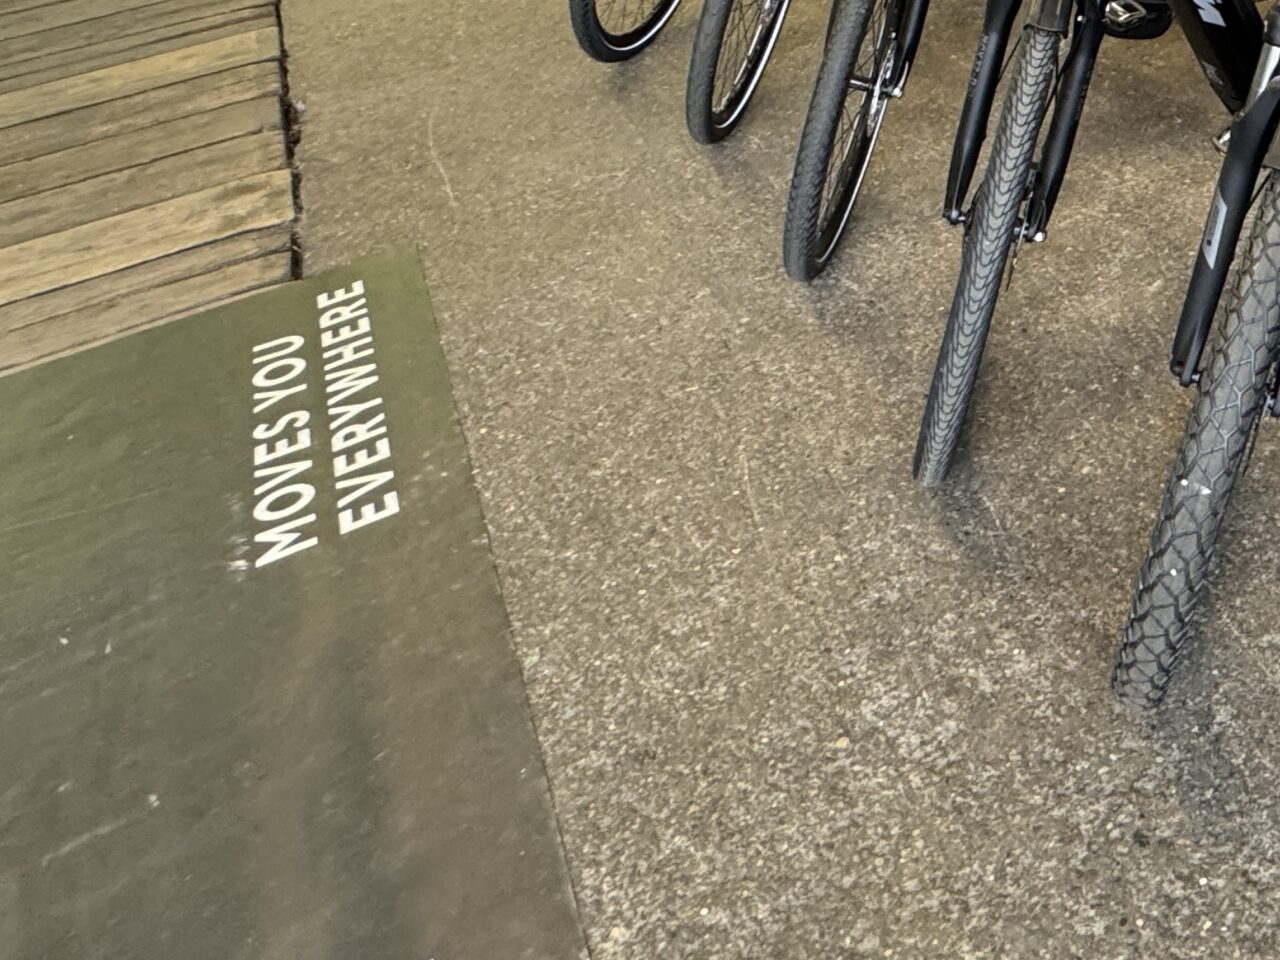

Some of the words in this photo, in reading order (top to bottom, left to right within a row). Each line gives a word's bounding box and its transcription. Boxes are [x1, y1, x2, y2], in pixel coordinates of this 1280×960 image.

[251, 334, 308, 414] YOU
[316, 279, 401, 536] EVERYWHERE
[252, 409, 319, 569] MOVES
